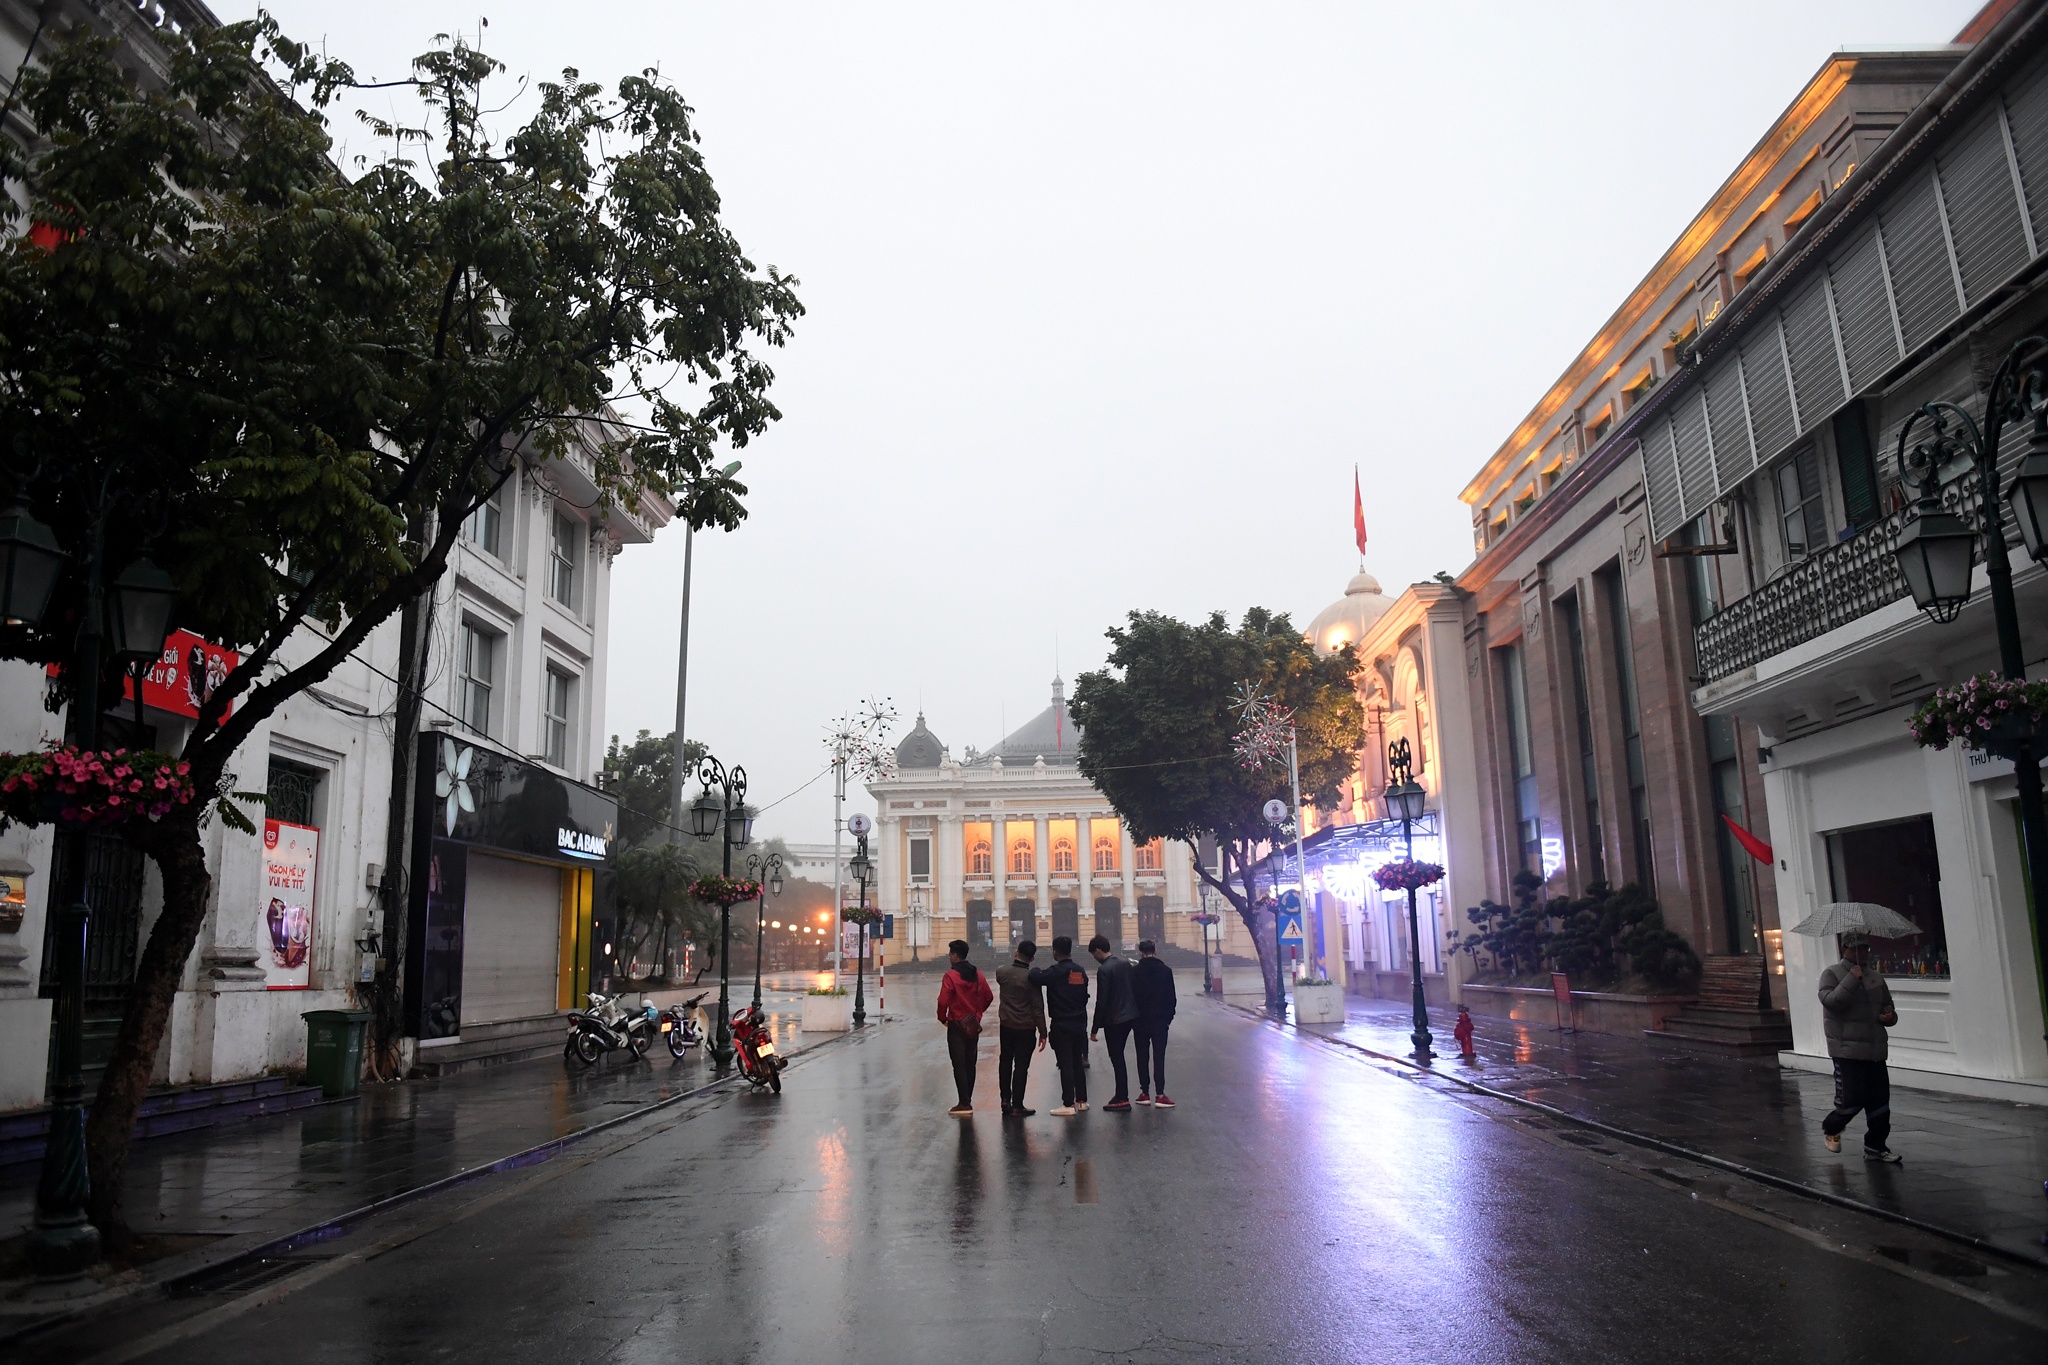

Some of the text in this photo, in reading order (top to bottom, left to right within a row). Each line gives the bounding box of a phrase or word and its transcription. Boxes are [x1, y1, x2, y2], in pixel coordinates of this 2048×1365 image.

[156, 669, 165, 684] LY
[558, 828, 606, 856] BAC A BANK
[268, 864, 288, 875] NGON
[297, 868, 306, 878] LY
[268, 875, 281, 887] VUI
